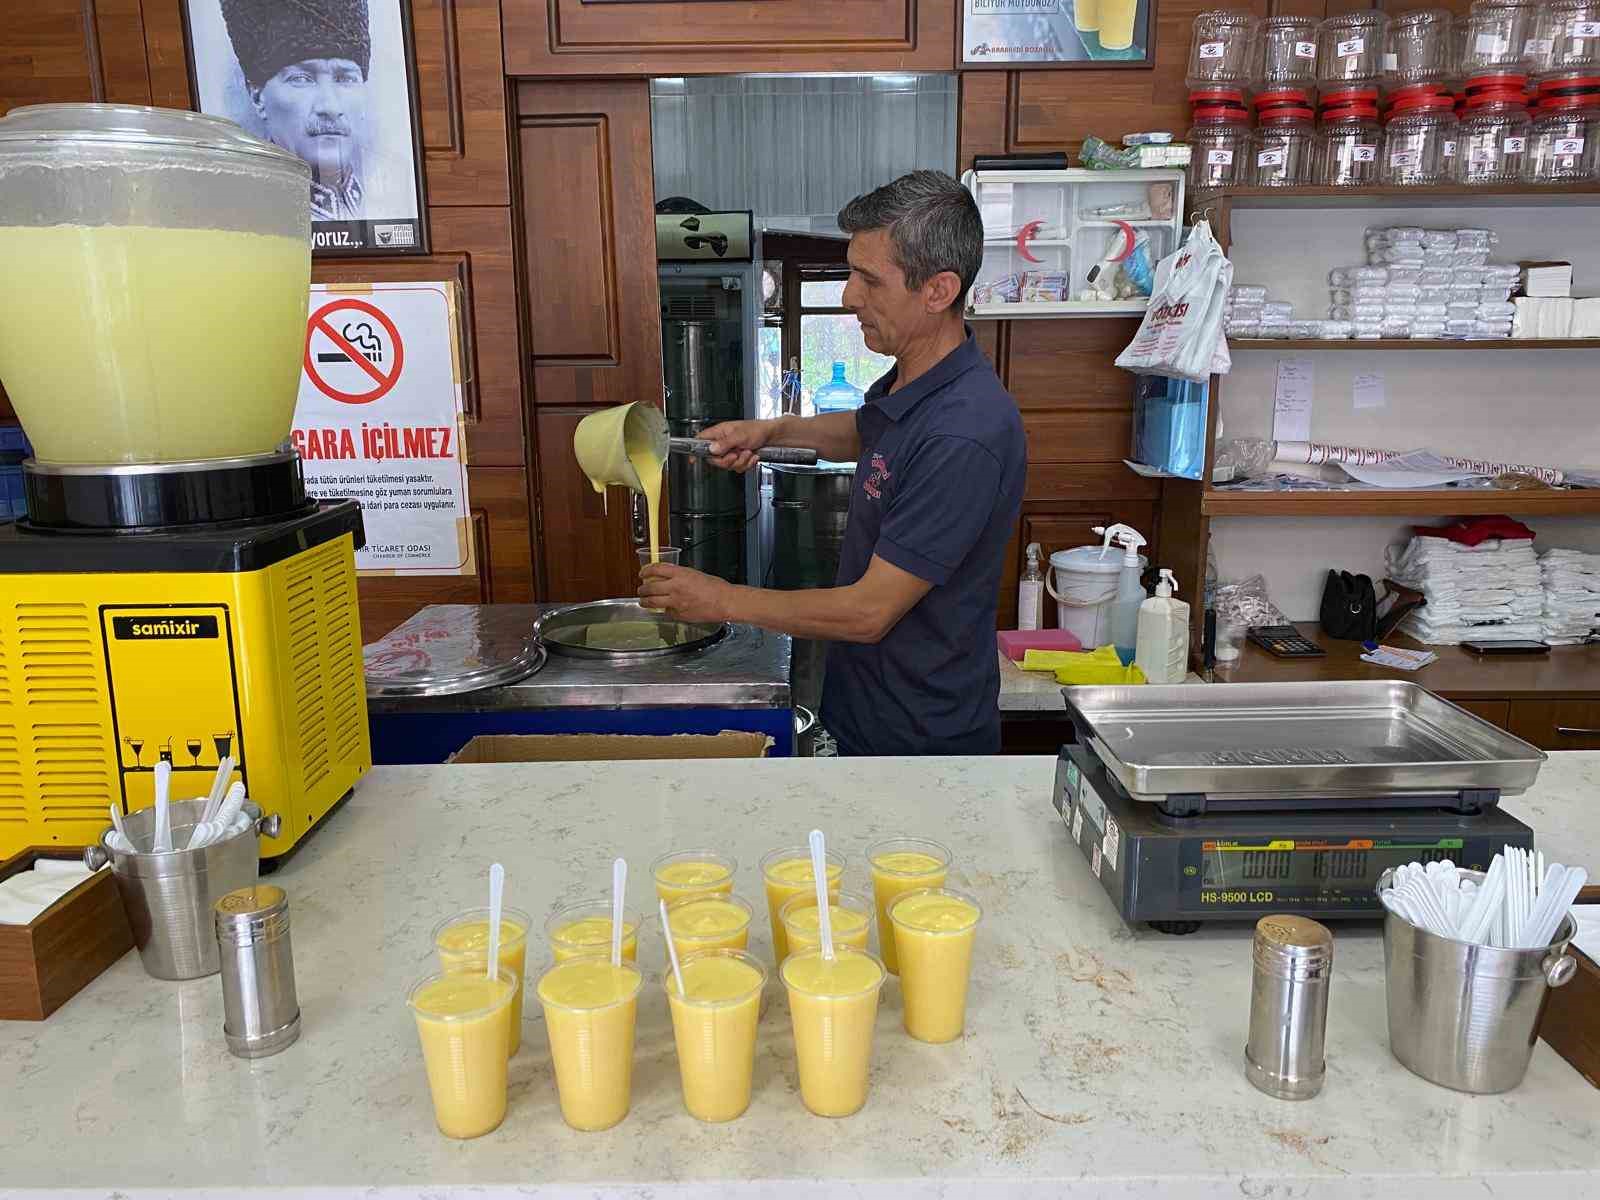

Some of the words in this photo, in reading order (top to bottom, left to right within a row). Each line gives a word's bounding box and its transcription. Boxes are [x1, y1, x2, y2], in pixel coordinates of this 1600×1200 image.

[361, 422, 454, 463] İÇİLMEZ
[320, 475, 338, 485] tütün
[340, 474, 365, 484] ürünleri
[366, 474, 405, 484] tüketilmesi
[406, 474, 434, 485] yasaktır.
[328, 488, 374, 497] tüketilmesine
[375, 487, 388, 498] göz
[389, 489, 412, 497] yuman
[413, 487, 453, 496] sorumlulara
[367, 500, 382, 510] idari
[383, 502, 399, 511] para
[400, 502, 422, 510] cezası
[423, 500, 456, 511] uygulanır.
[371, 543, 404, 553] TİCARET
[406, 543, 431, 553] ODASI
[1200, 891, 1247, 904] HS-9500
[1249, 891, 1273, 904] LCD
